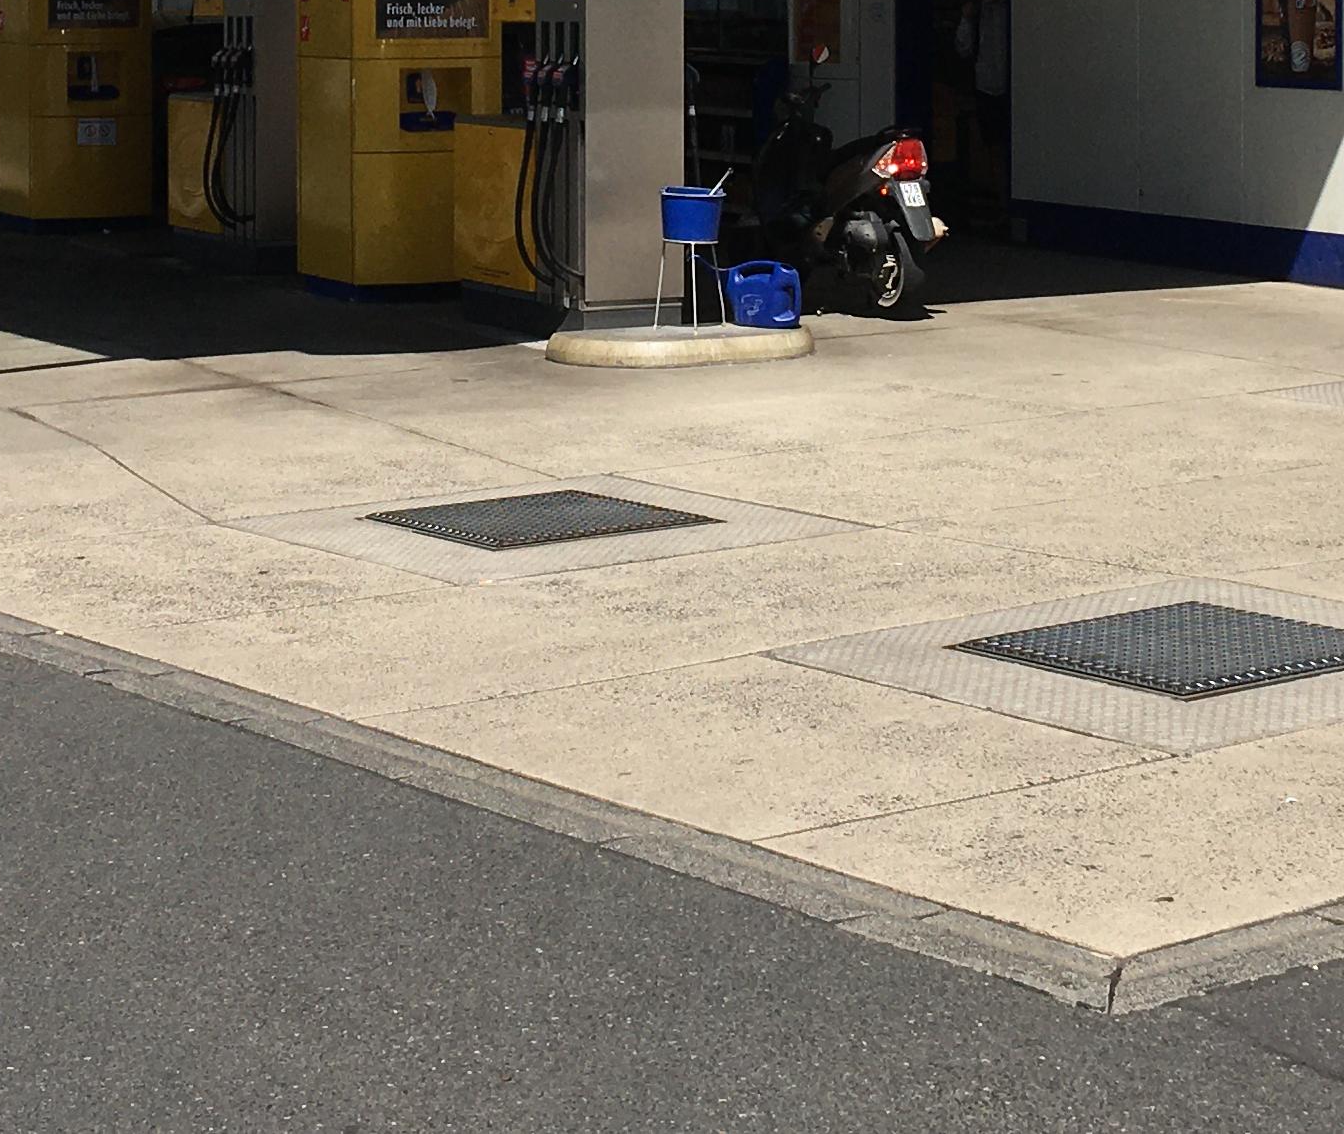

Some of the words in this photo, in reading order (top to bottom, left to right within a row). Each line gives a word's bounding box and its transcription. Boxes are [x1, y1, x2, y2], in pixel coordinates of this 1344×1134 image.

[386, 2, 415, 16] Frisch,
[417, 2, 445, 15] lecker
[386, 17, 404, 28] und
[406, 17, 421, 27] mit
[424, 16, 448, 27] Liebe
[449, 16, 478, 29] belegt.
